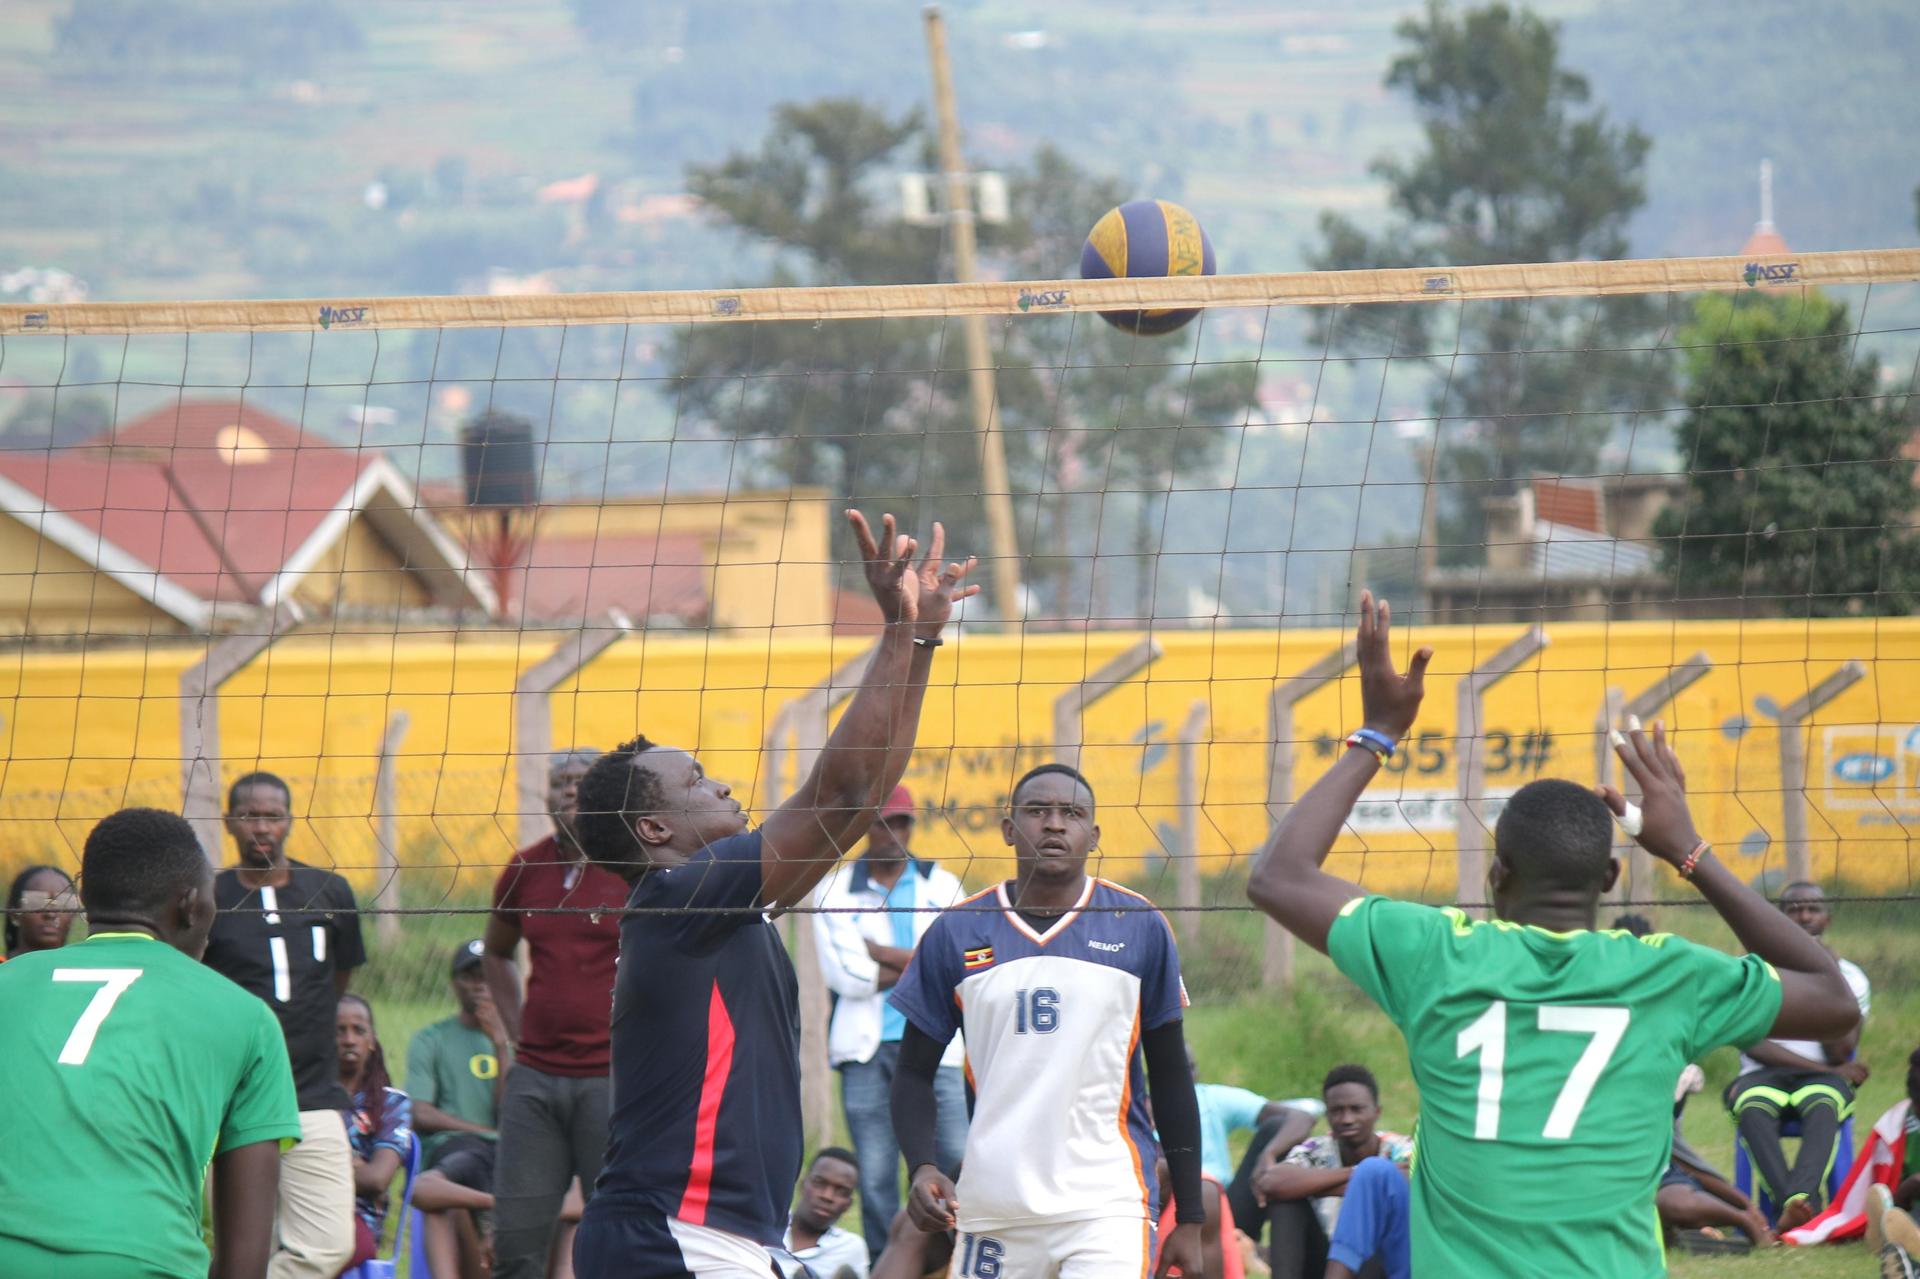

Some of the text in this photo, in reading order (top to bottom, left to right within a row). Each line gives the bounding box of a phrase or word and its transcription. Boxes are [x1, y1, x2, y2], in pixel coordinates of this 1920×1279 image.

[1757, 263, 1798, 281] NSSF
[1030, 290, 1070, 306] NSSF
[330, 307, 369, 323] NSSF
[1088, 940, 1120, 953] NEMO
[51, 968, 144, 1065] 7
[1014, 986, 1061, 1035] 16
[1457, 1000, 1631, 1140] 17
[960, 1232, 1006, 1279] 16
